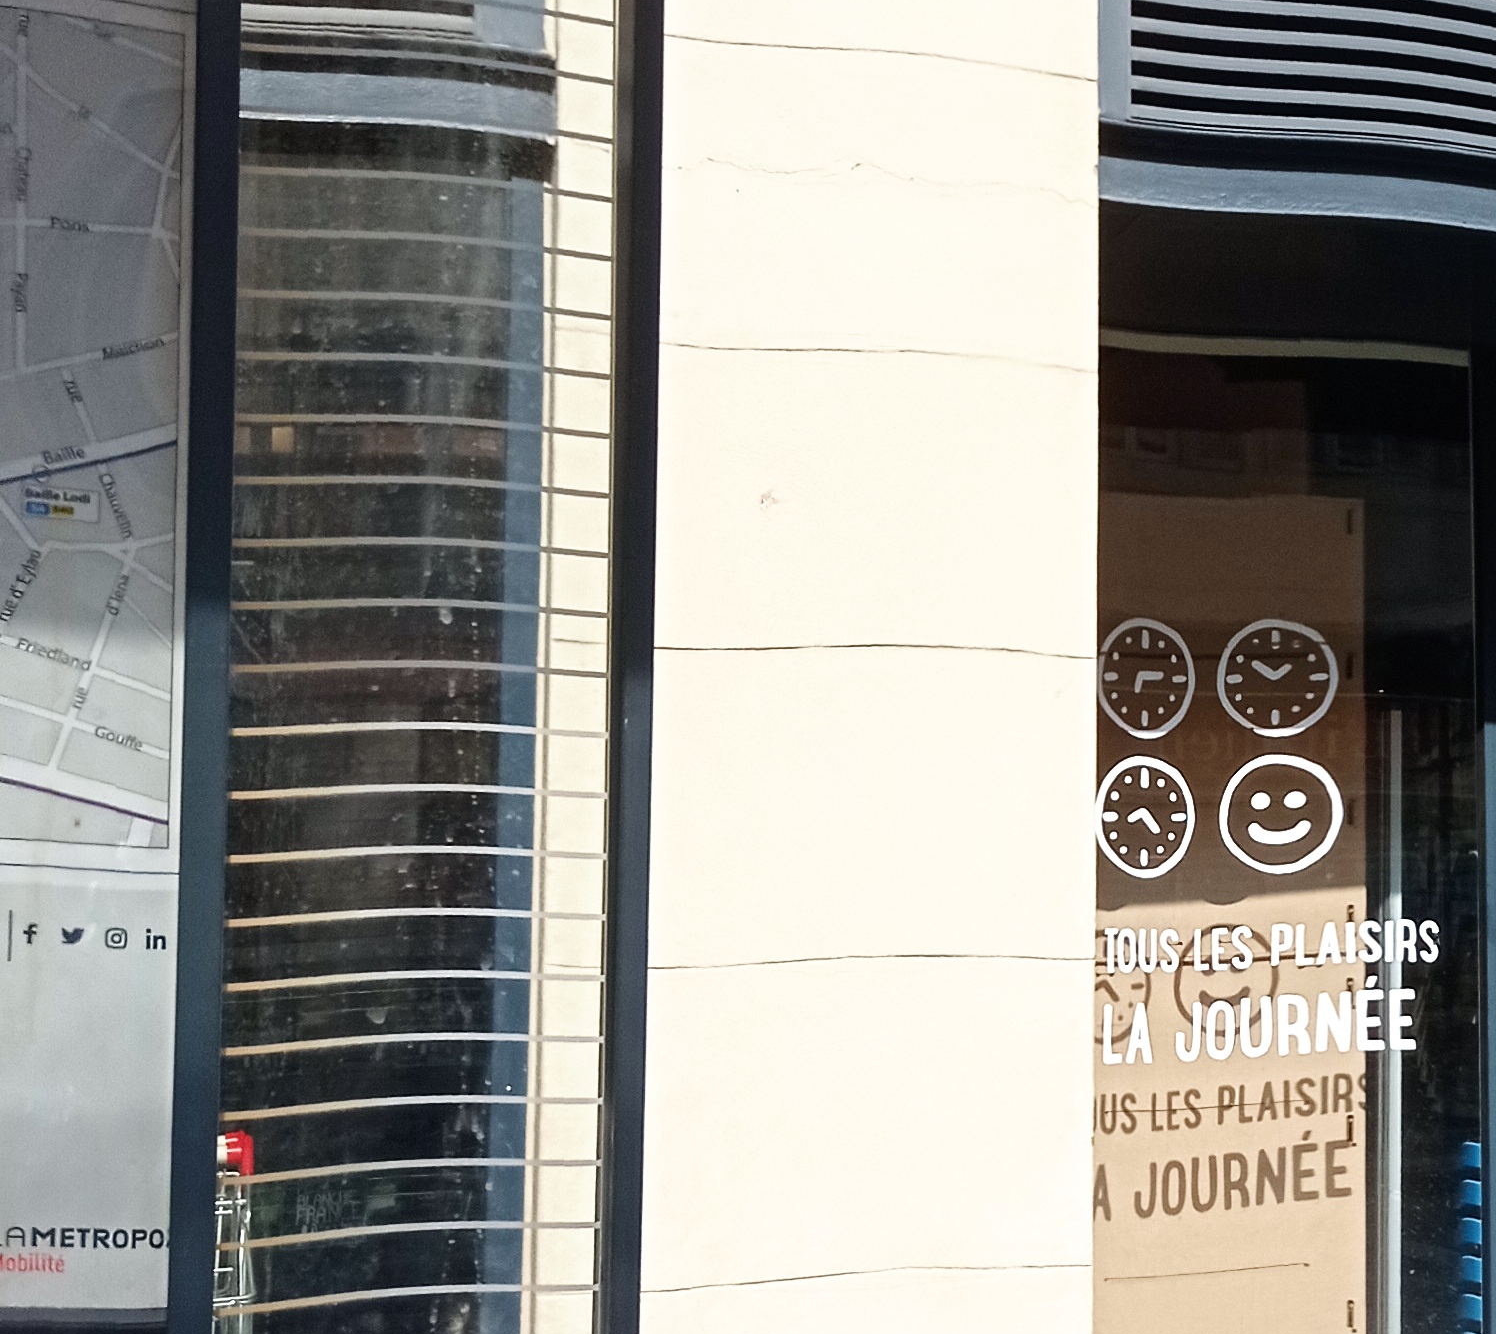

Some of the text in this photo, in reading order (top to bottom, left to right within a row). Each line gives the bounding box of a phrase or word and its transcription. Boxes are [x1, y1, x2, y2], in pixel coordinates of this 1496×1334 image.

[42, 445, 85, 466] Baille
[16, 637, 92, 671] Friedland
[72, 687, 88, 709] rue
[1104, 918, 1441, 974] TOUS LES PLAISIRS
[1103, 975, 1417, 1065] LA JOURNÉE
[0, 1226, 170, 1250] AMETROPO
